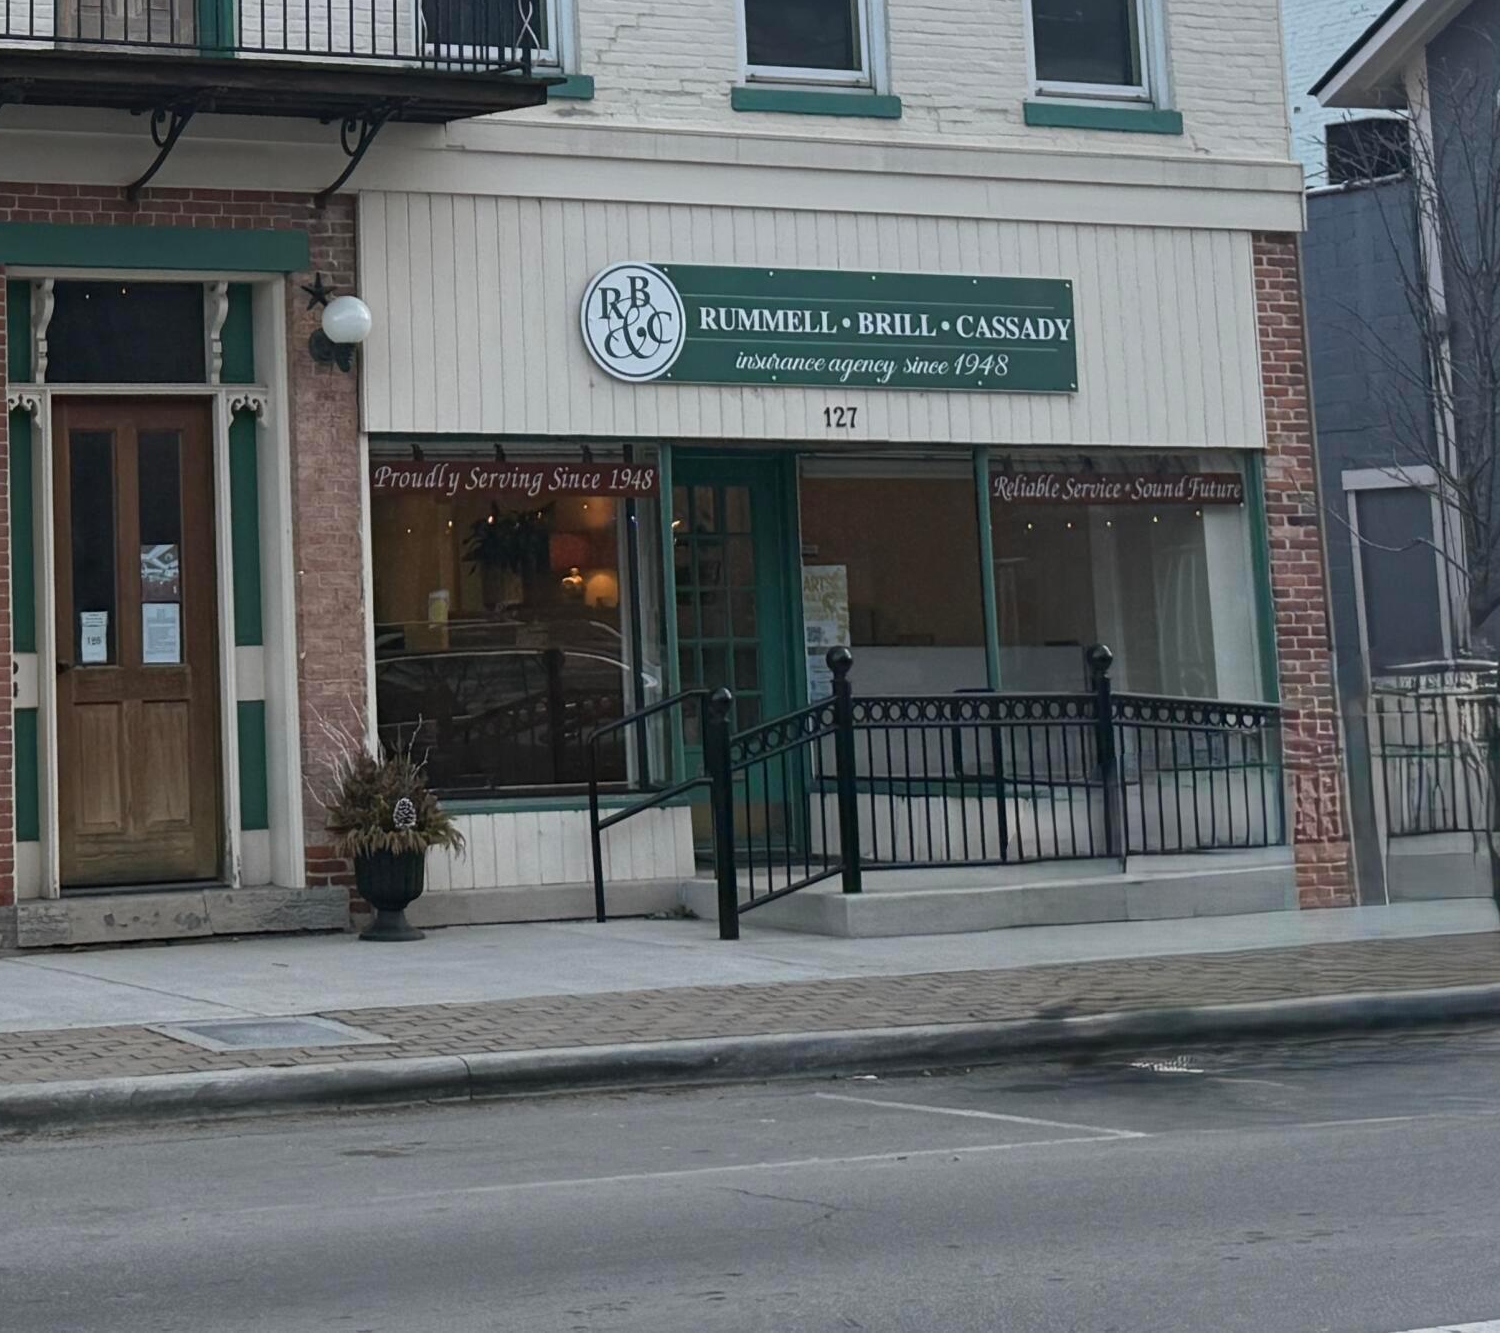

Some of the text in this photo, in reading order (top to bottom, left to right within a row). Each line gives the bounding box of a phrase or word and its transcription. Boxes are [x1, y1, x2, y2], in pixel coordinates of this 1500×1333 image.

[699, 306, 1072, 340] RUMMELL BRILL CASSADY
[735, 351, 1009, 384] insurance agency since 1948
[823, 406, 858, 428] 127
[374, 463, 654, 497] Proudly Serving Since 1948
[993, 475, 1242, 501] Reliable Service Sound Future
